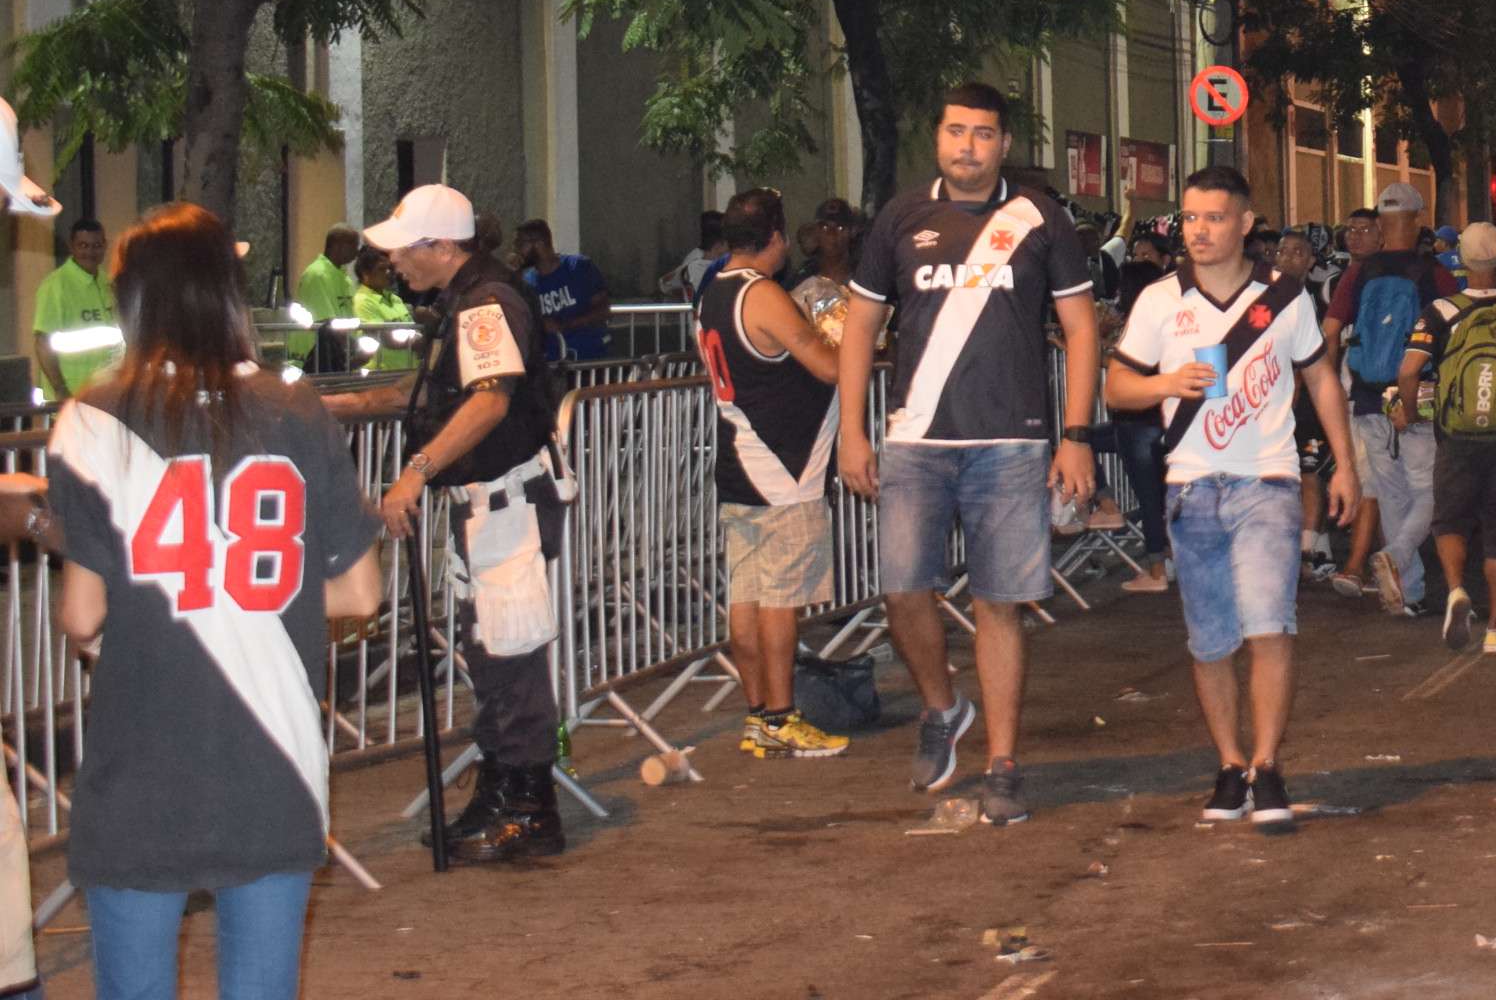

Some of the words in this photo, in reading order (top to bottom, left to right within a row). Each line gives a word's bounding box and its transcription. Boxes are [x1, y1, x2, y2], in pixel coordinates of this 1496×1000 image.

[914, 263, 1014, 291] CAIXA
[539, 285, 577, 315] ISCAL
[1476, 363, 1494, 412] BORN
[129, 454, 305, 614] 48
